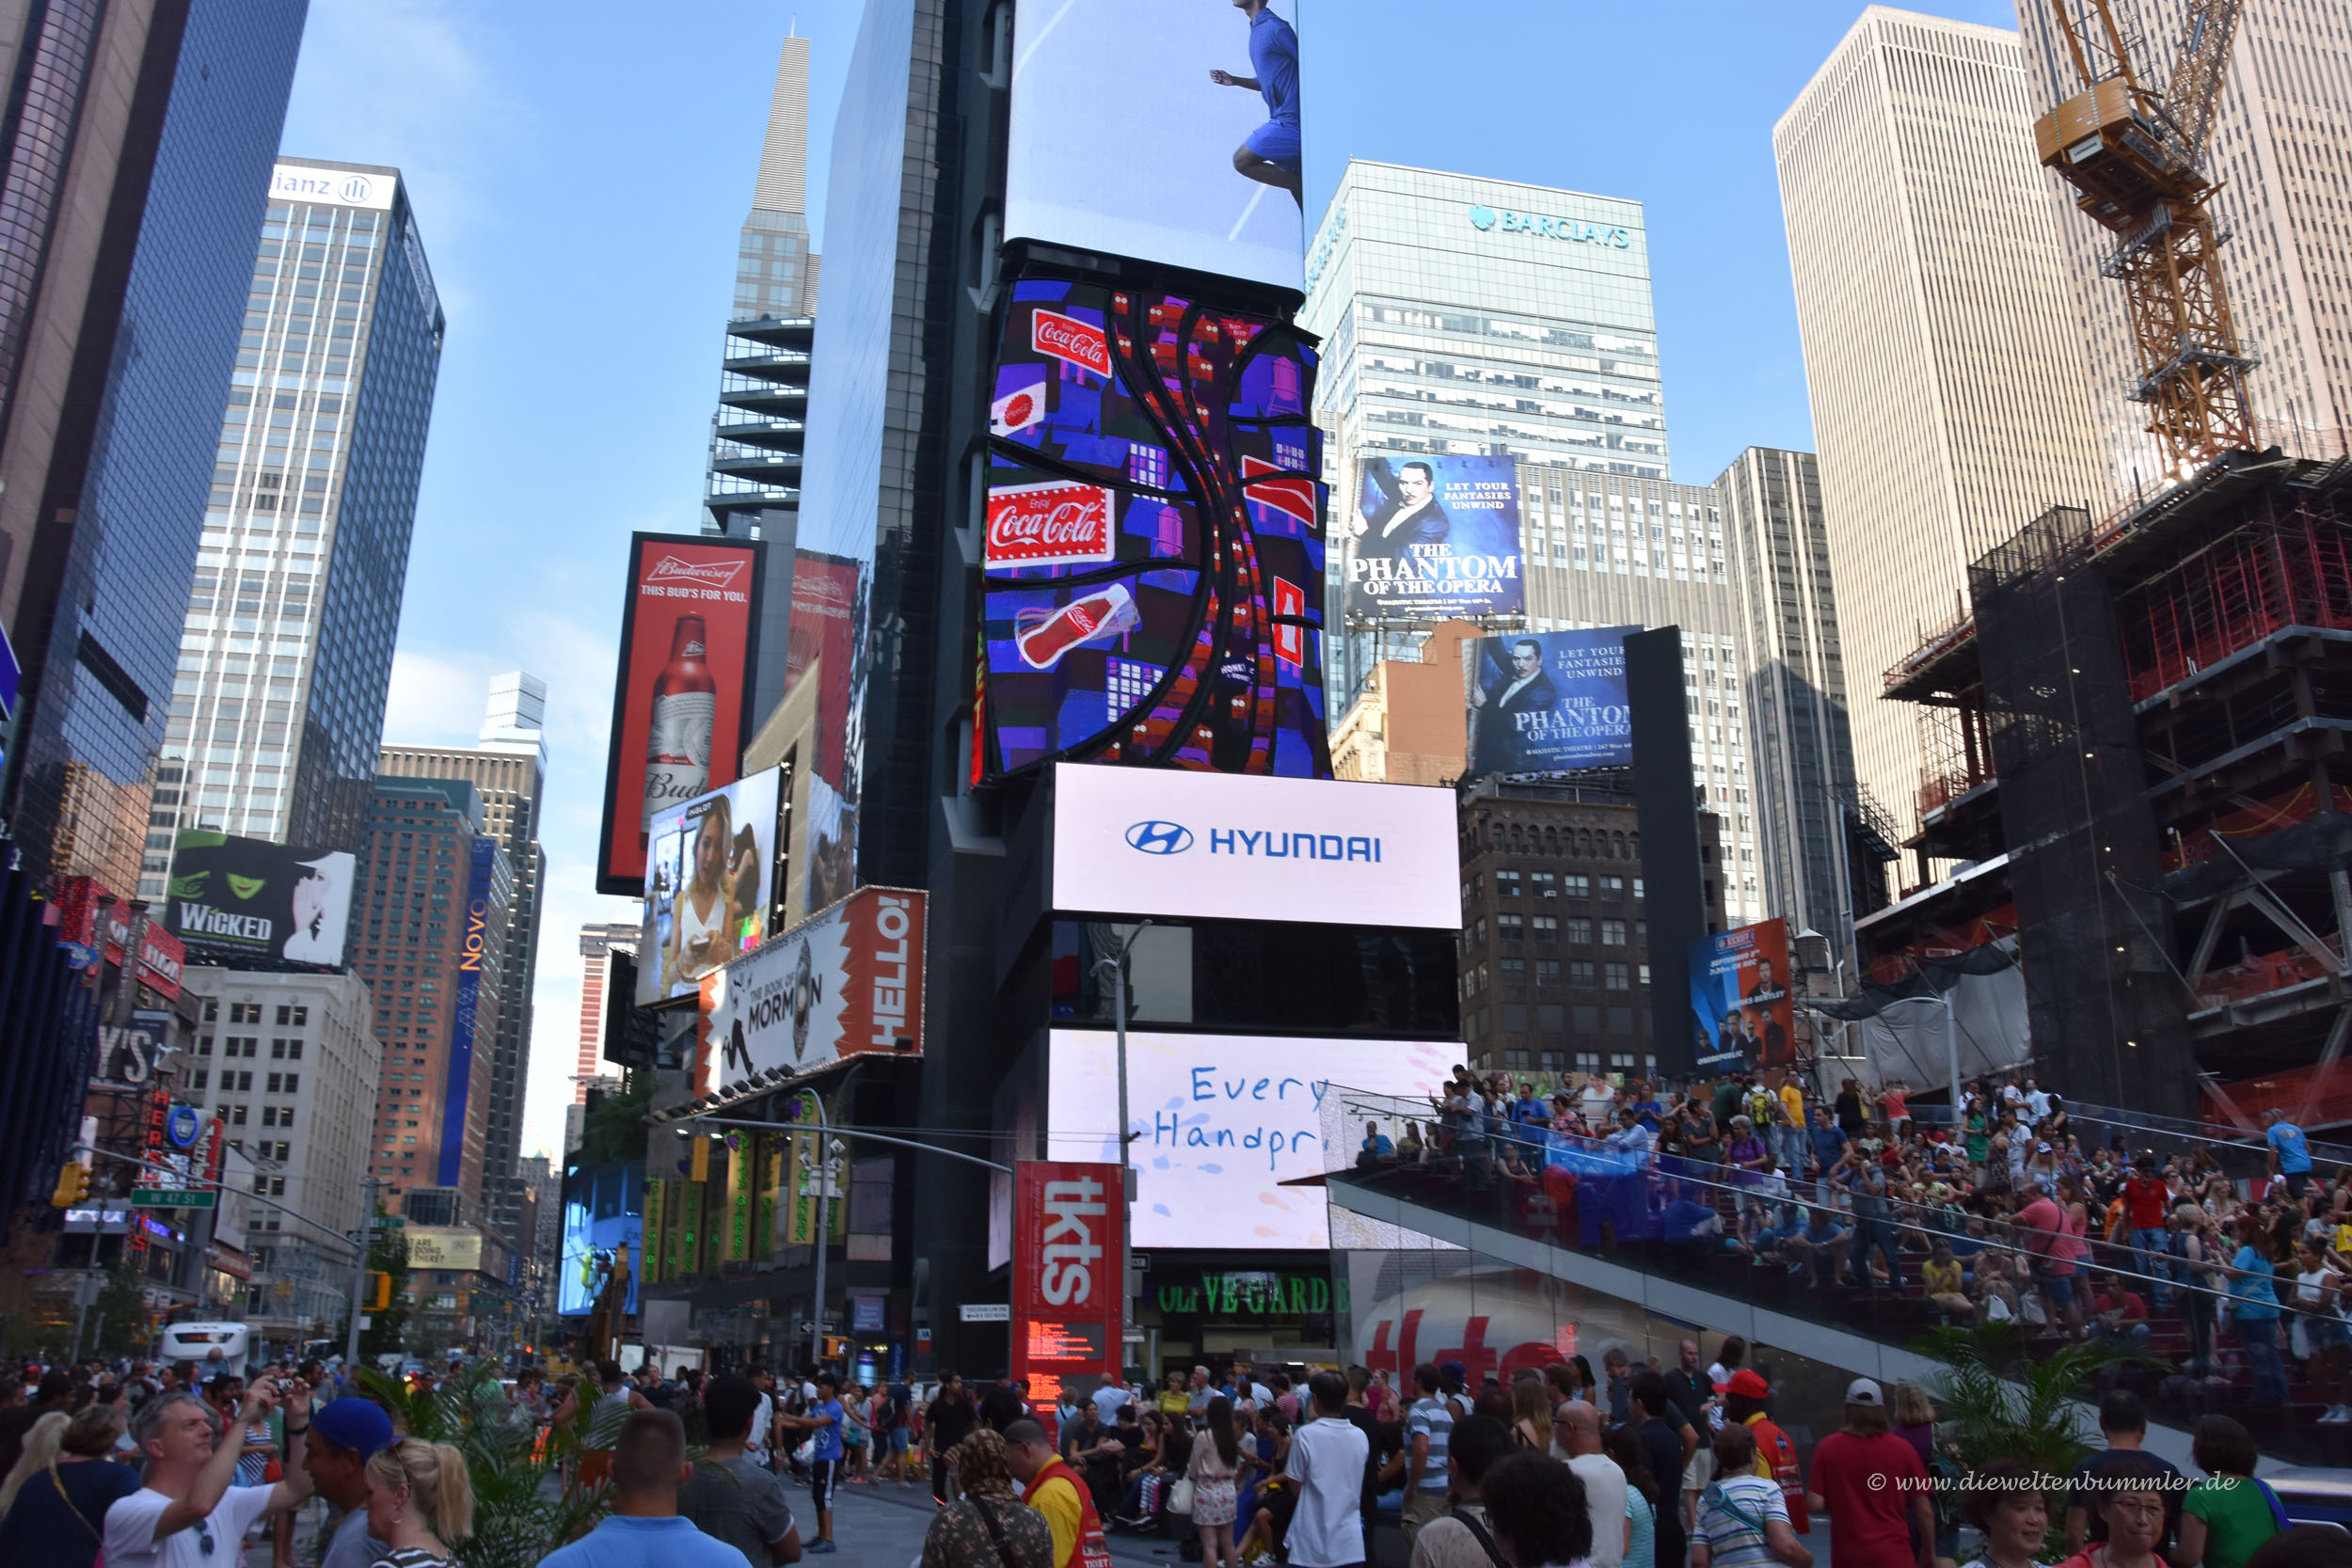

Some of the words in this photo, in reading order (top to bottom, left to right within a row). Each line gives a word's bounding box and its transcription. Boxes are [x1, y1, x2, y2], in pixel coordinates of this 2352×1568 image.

[1502, 210, 1629, 249] BARCLAYS
[1038, 321, 1106, 363] Coca-Cola
[1446, 483, 1470, 491] LET
[1475, 482, 1510, 491] YOUR
[1444, 491, 1511, 500] FANTASIES
[1452, 501, 1505, 510] UNWIND
[991, 502, 1102, 547] Coca-Cola
[1409, 543, 1453, 558] THE
[656, 562, 734, 578] Budweiser
[1348, 556, 1518, 582] PHANTOM
[642, 584, 664, 596] THIS
[667, 587, 699, 598] BUD'S
[701, 589, 721, 600] FOR
[723, 592, 747, 602] YOU.
[1364, 580, 1391, 595] OF
[1393, 580, 1436, 594] THE
[1438, 579, 1503, 594] OPERA
[1560, 649, 1583, 658] LET
[1566, 668, 1623, 679] UNWIND
[1562, 697, 1594, 708] THE
[1528, 729, 1547, 741] OF
[1550, 727, 1581, 739] THE
[1211, 828, 1382, 863] HYUNDAI
[871, 895, 910, 1047] HELLO!
[1191, 1067, 1329, 1113] Every
[151, 1194, 162, 1203] W
[1041, 1176, 1106, 1306] tkts
